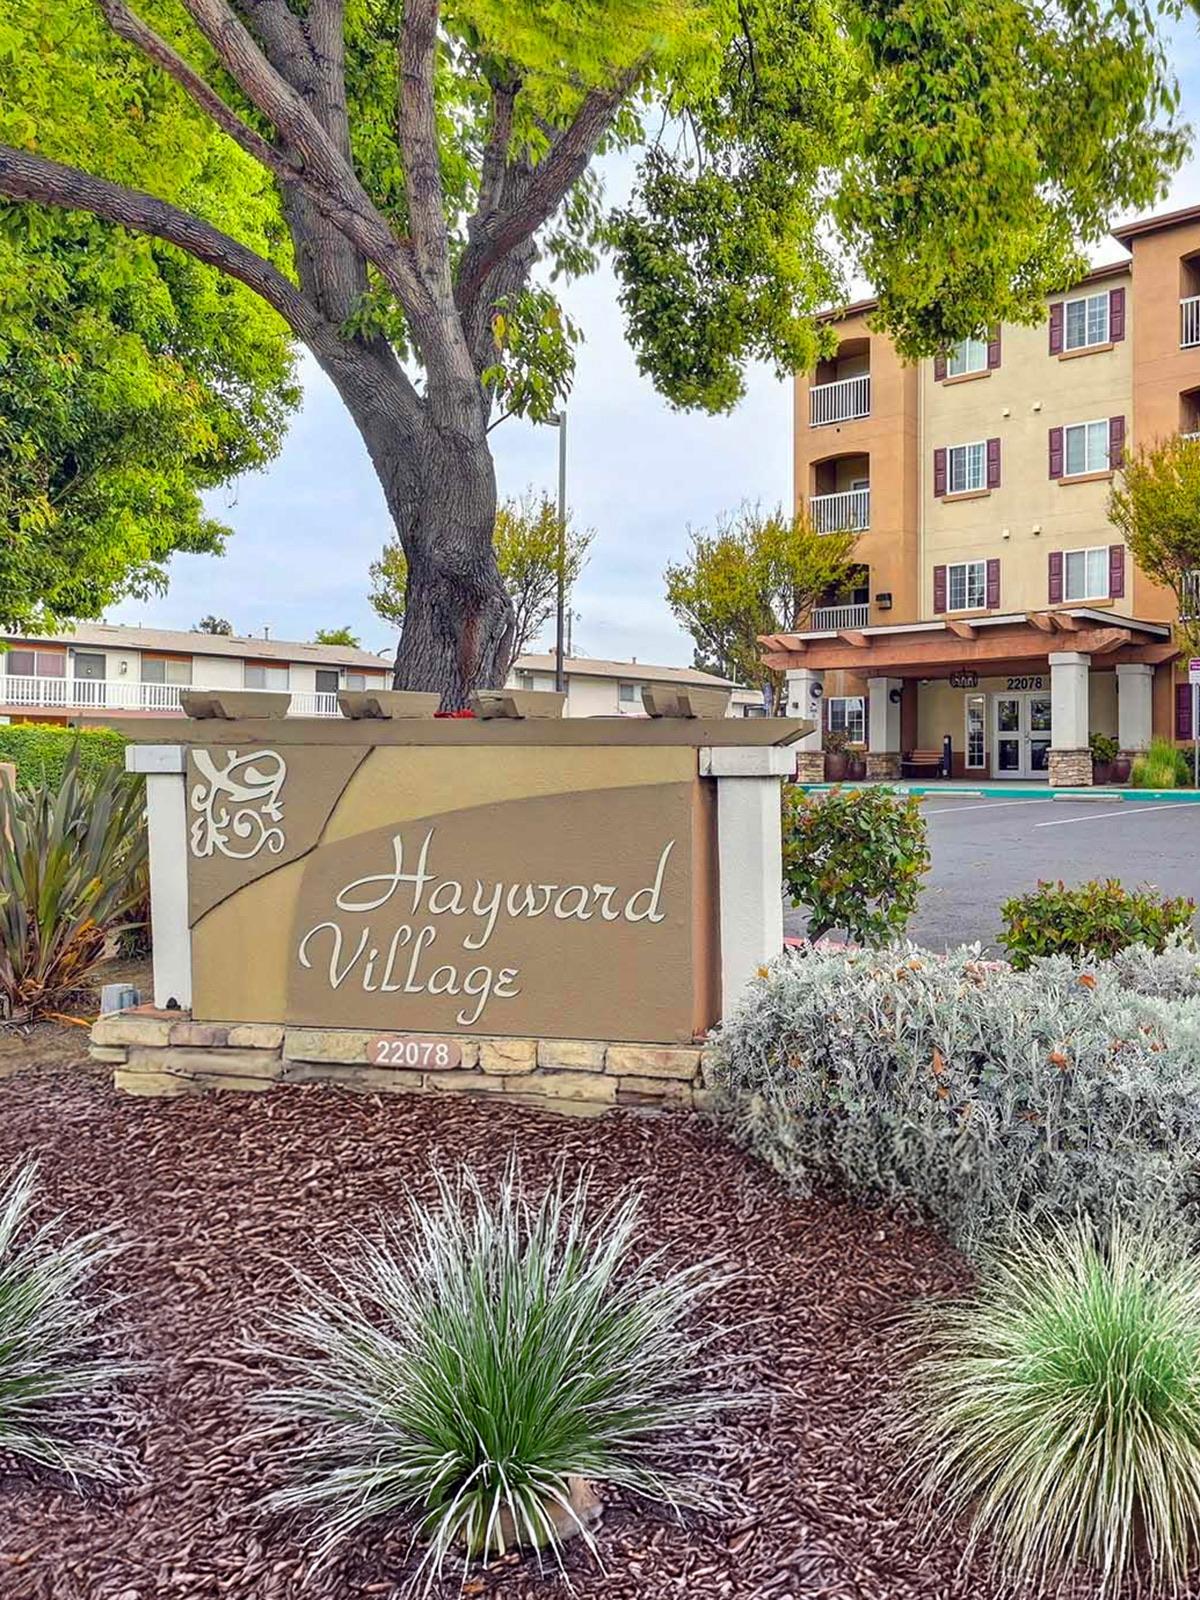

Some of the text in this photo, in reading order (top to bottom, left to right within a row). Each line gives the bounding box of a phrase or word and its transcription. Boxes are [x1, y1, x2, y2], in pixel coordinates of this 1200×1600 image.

[1007, 677, 1043, 690] 22078
[335, 828, 676, 950] Hayward
[298, 921, 522, 1027] Village
[376, 1040, 449, 1065] 22078
